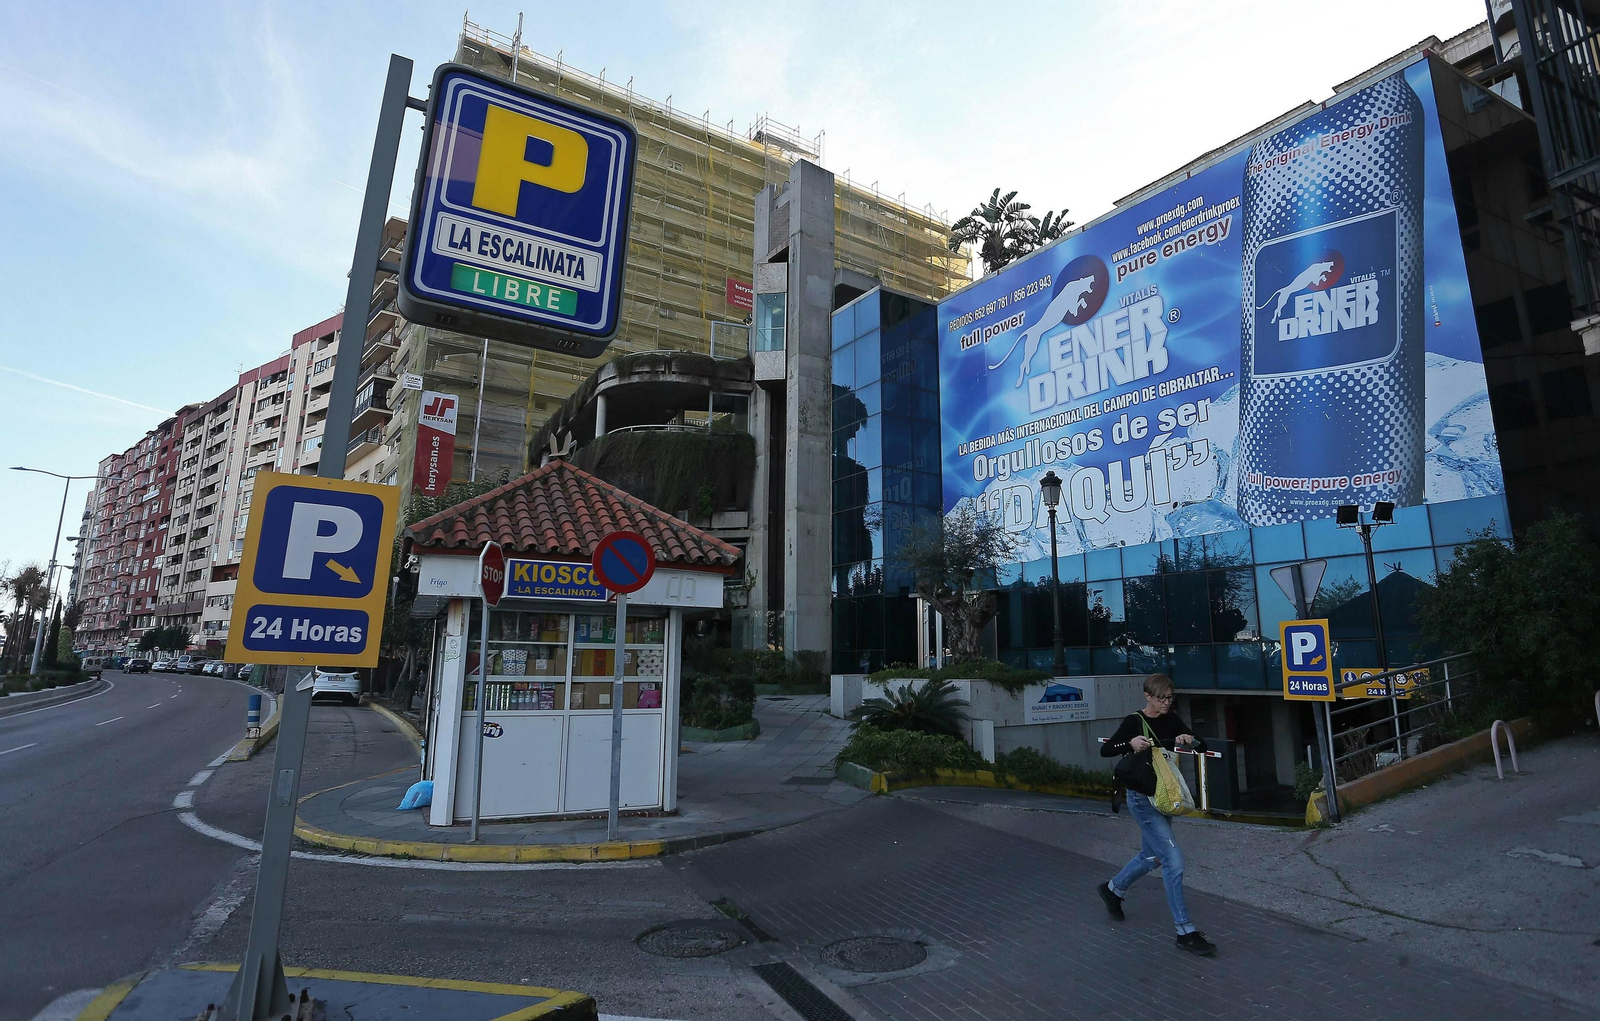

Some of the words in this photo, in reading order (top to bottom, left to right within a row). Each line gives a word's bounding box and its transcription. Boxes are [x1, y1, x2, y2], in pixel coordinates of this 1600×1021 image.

[472, 103, 588, 217] P
[1265, 138, 1315, 169] original
[1320, 122, 1375, 148] Energy
[1379, 112, 1412, 130] Drink
[1111, 195, 1241, 263] www.facebook.com/enerdrinkproex
[1136, 195, 1204, 235] www.proexdg.com
[448, 223, 471, 252] LA
[477, 230, 585, 281] ESCALINATA
[1117, 251, 1157, 282] pure
[1162, 217, 1230, 257] energy
[472, 272, 561, 310] LIBRE
[1119, 284, 1158, 308] VITALIS
[1350, 272, 1376, 283] VITALIS
[949, 312, 975, 333] PEDIDOS:
[975, 307, 986, 321] 652
[986, 300, 997, 315] 697
[997, 295, 1008, 310] 781
[1014, 287, 1026, 302] 856
[1026, 281, 1039, 297] 223
[1039, 275, 1052, 290] 943
[1295, 279, 1380, 318] ENER
[961, 329, 980, 349] full
[984, 312, 1024, 343] power
[1048, 295, 1168, 369] ENER
[1279, 300, 1379, 341] DRINK
[1027, 330, 1169, 414] DRINK
[422, 415, 454, 424] HERYSAN
[958, 443, 968, 457] LA
[969, 434, 997, 453] BEBIDA
[998, 426, 1015, 445] MÁS
[1016, 408, 1082, 440] INTERNACIONAL
[1083, 401, 1102, 420] DEL
[1103, 389, 1140, 414] CAMPO
[1141, 385, 1157, 403] DE
[1158, 366, 1234, 397] GIBRALTAR...
[973, 428, 1104, 482] Orgullosos
[1112, 413, 1148, 445] de
[1157, 397, 1211, 432] ser
[425, 436, 440, 491] herysan.es
[1247, 473, 1262, 485] full
[1353, 468, 1403, 486] energy
[282, 501, 364, 580] P
[429, 577, 448, 588] Frigo
[483, 565, 503, 584] STOP
[250, 616, 283, 639] 24
[290, 618, 362, 643] Horas
[1291, 632, 1317, 665] P
[1290, 681, 1300, 691] 24
[1302, 680, 1327, 692] Horas
